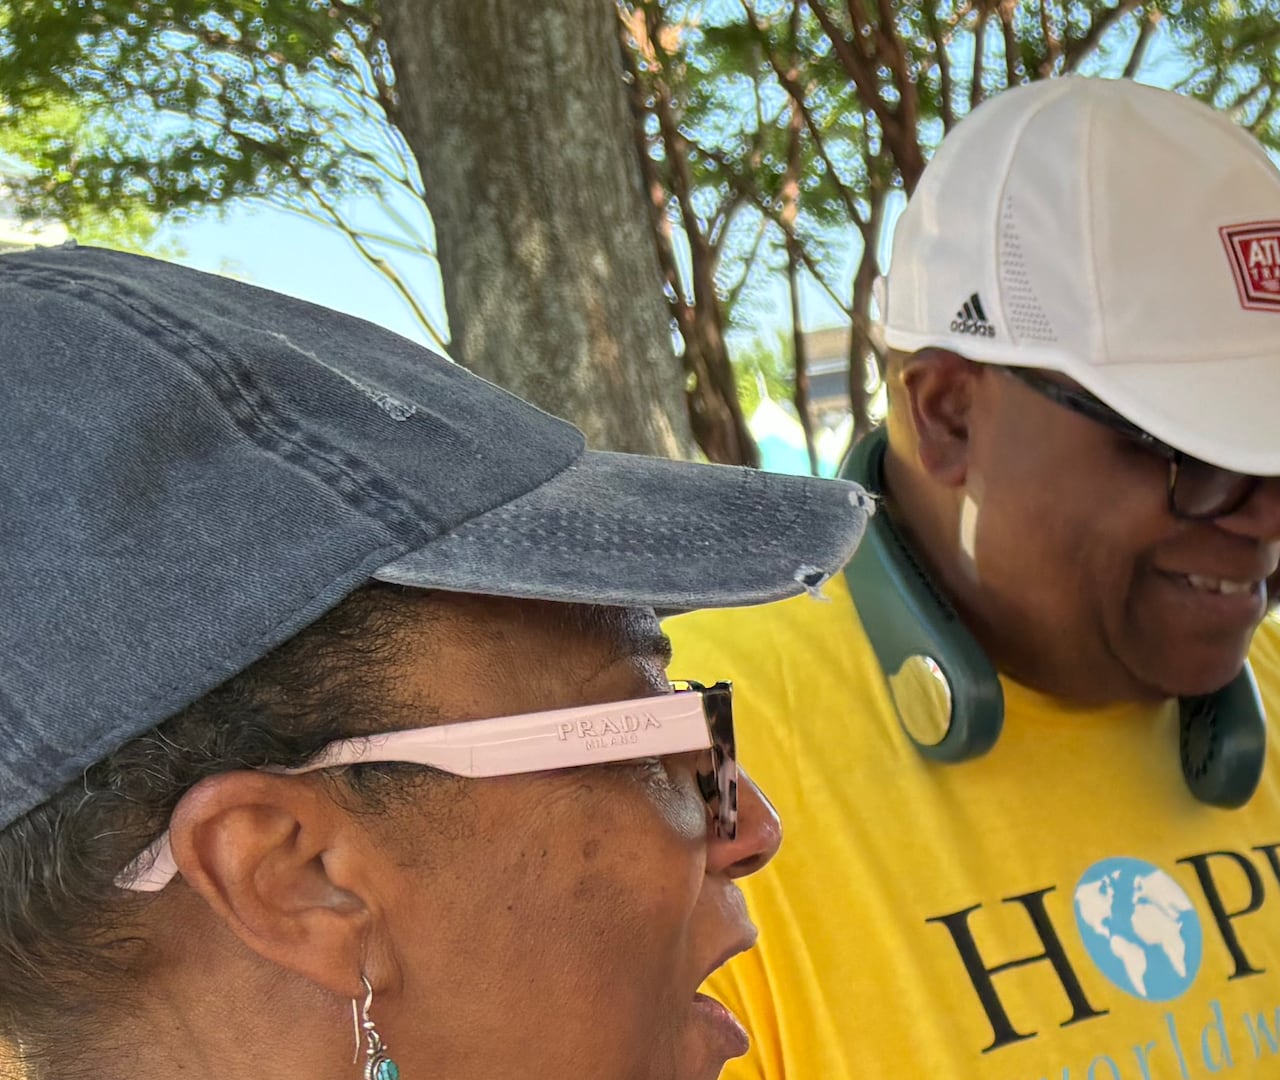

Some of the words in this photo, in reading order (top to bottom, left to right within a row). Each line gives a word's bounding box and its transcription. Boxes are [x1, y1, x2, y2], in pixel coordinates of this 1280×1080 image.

[950, 317, 997, 339] adidas
[556, 711, 662, 742] PRADA
[584, 733, 639, 751] MILANO
